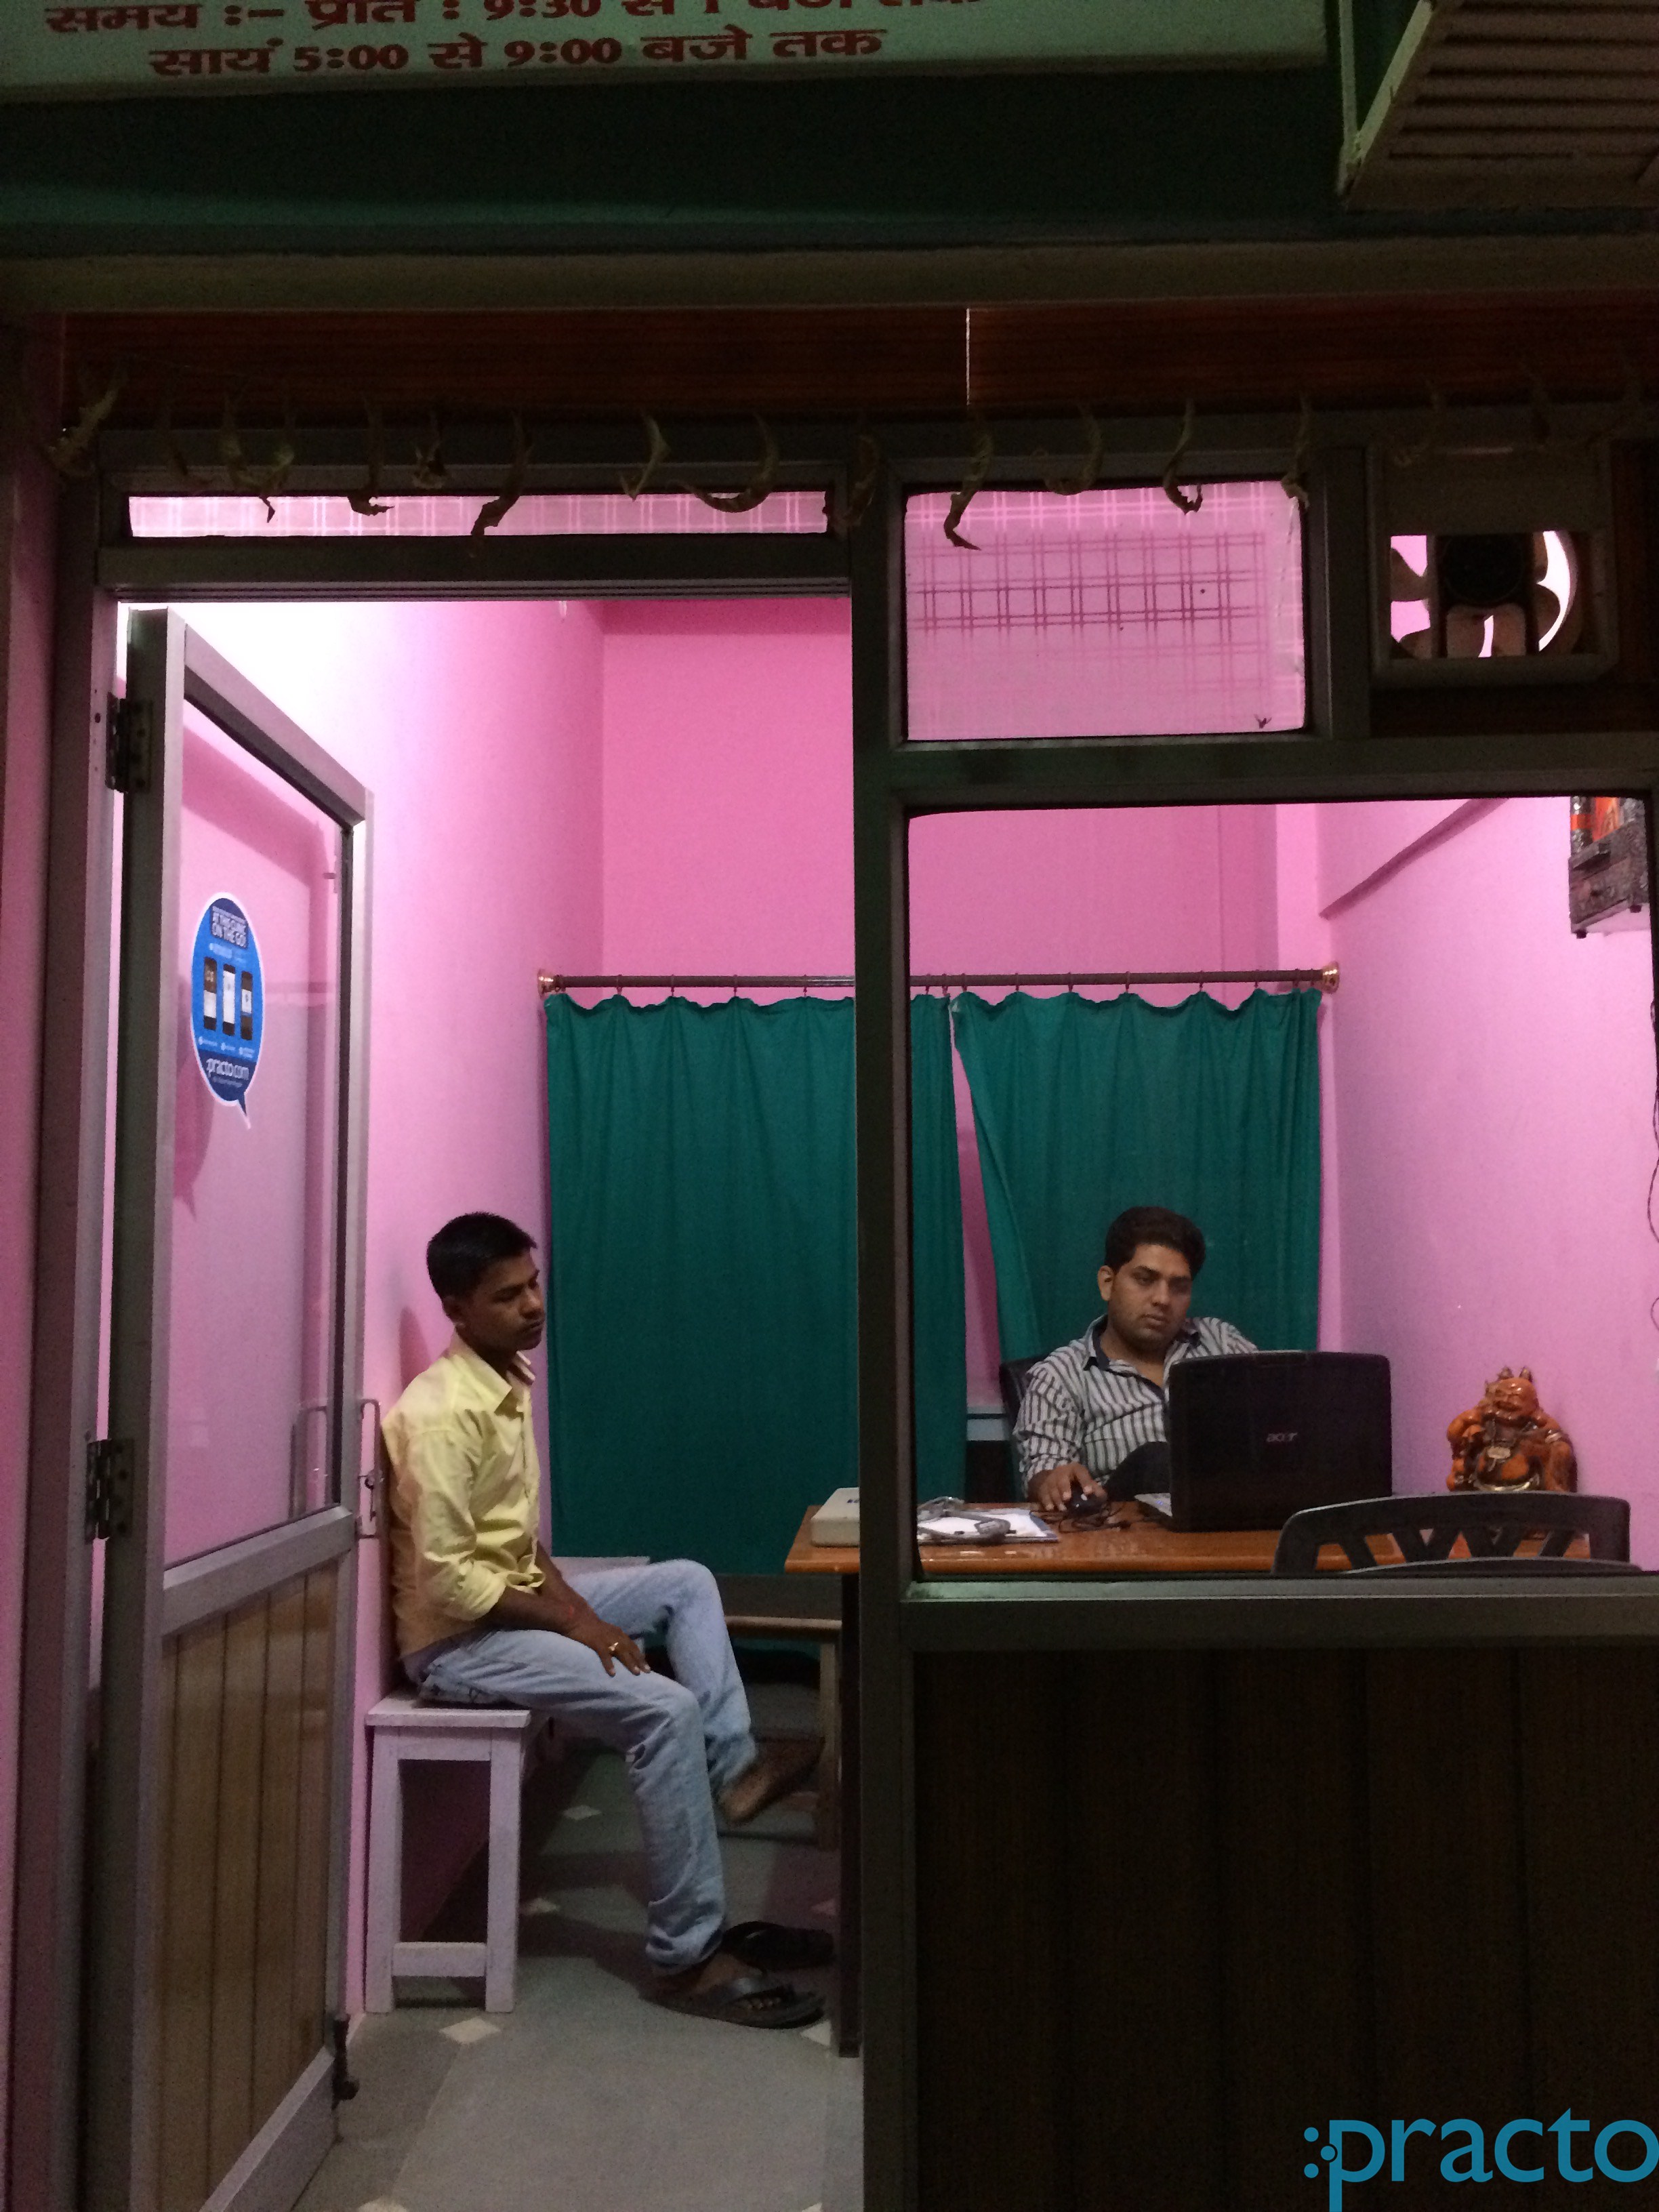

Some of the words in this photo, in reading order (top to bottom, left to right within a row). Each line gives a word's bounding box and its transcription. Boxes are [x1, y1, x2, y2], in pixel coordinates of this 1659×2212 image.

[45, 4, 201, 33] समय
[484, 0, 600, 20] 9:30
[621, 0, 674, 16] स
[293, 44, 409, 71] 5:00
[427, 32, 488, 68] से
[504, 37, 622, 66] 9:00
[640, 24, 752, 62] बजे
[769, 29, 887, 57] तक
